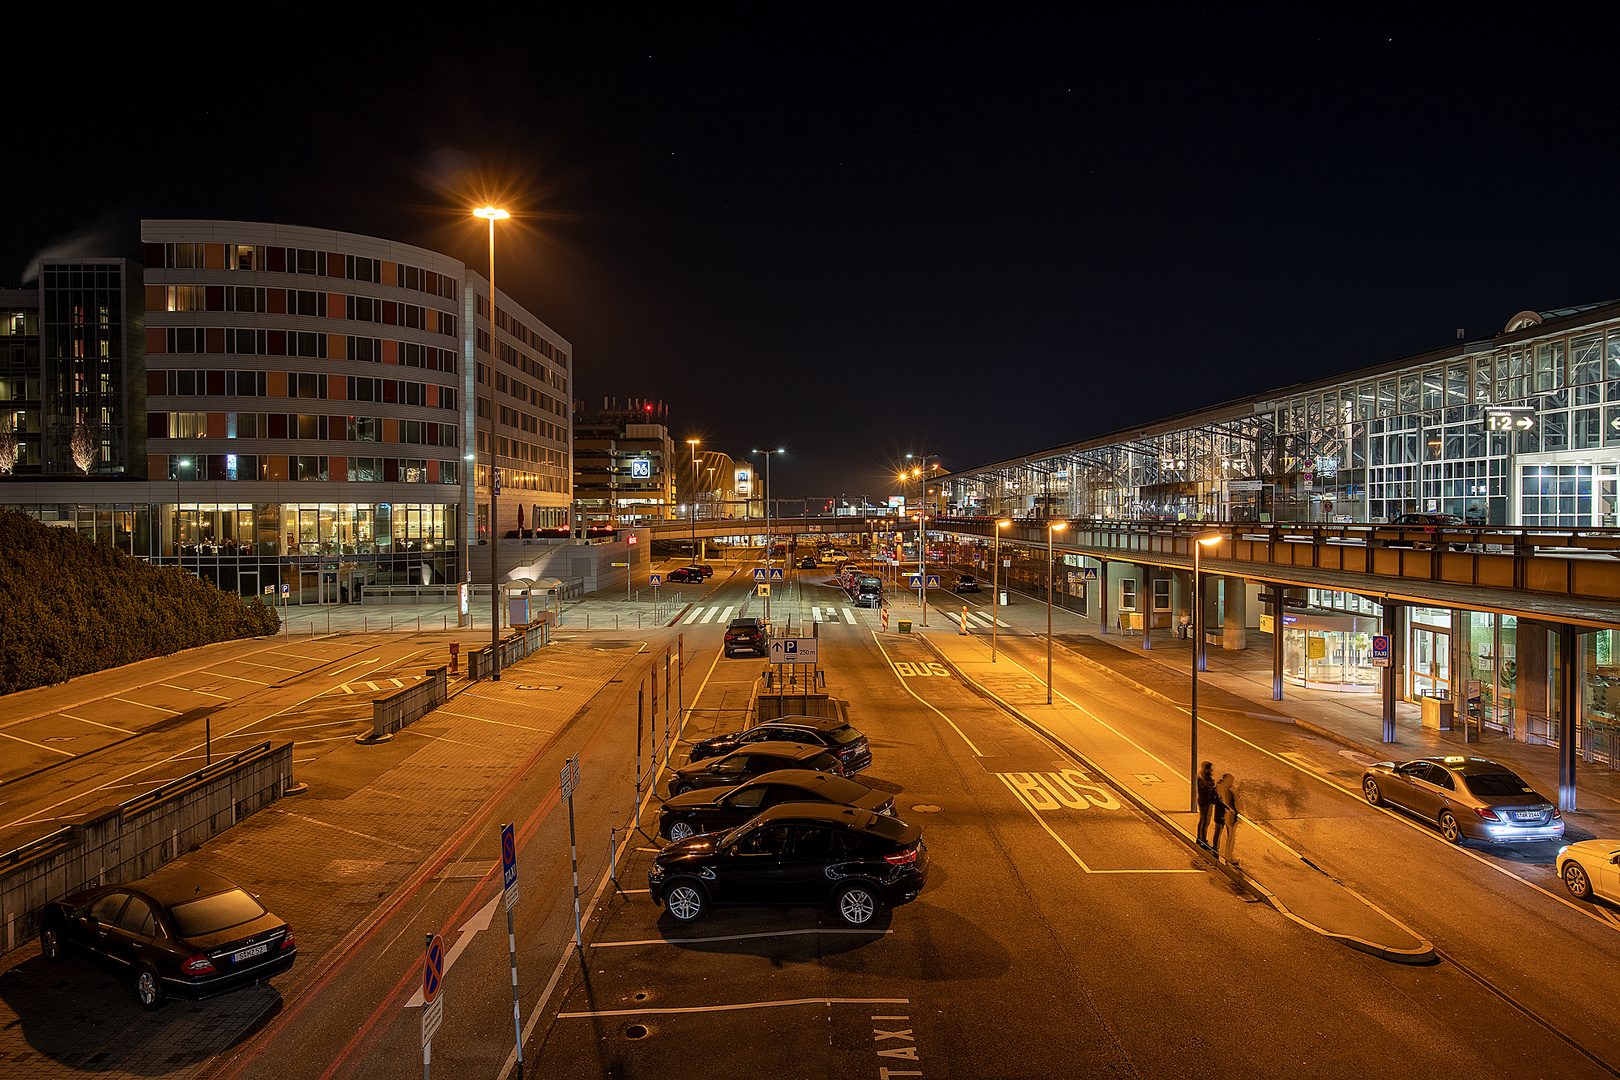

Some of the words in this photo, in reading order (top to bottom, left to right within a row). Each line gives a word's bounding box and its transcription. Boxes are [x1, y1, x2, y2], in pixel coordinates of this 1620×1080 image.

[633, 464, 648, 476] P6
[787, 642, 794, 652] P
[894, 662, 950, 677] BUS
[1003, 769, 1121, 810] BUS
[504, 864, 516, 884] TAXI
[871, 1016, 922, 1080] TAXI
